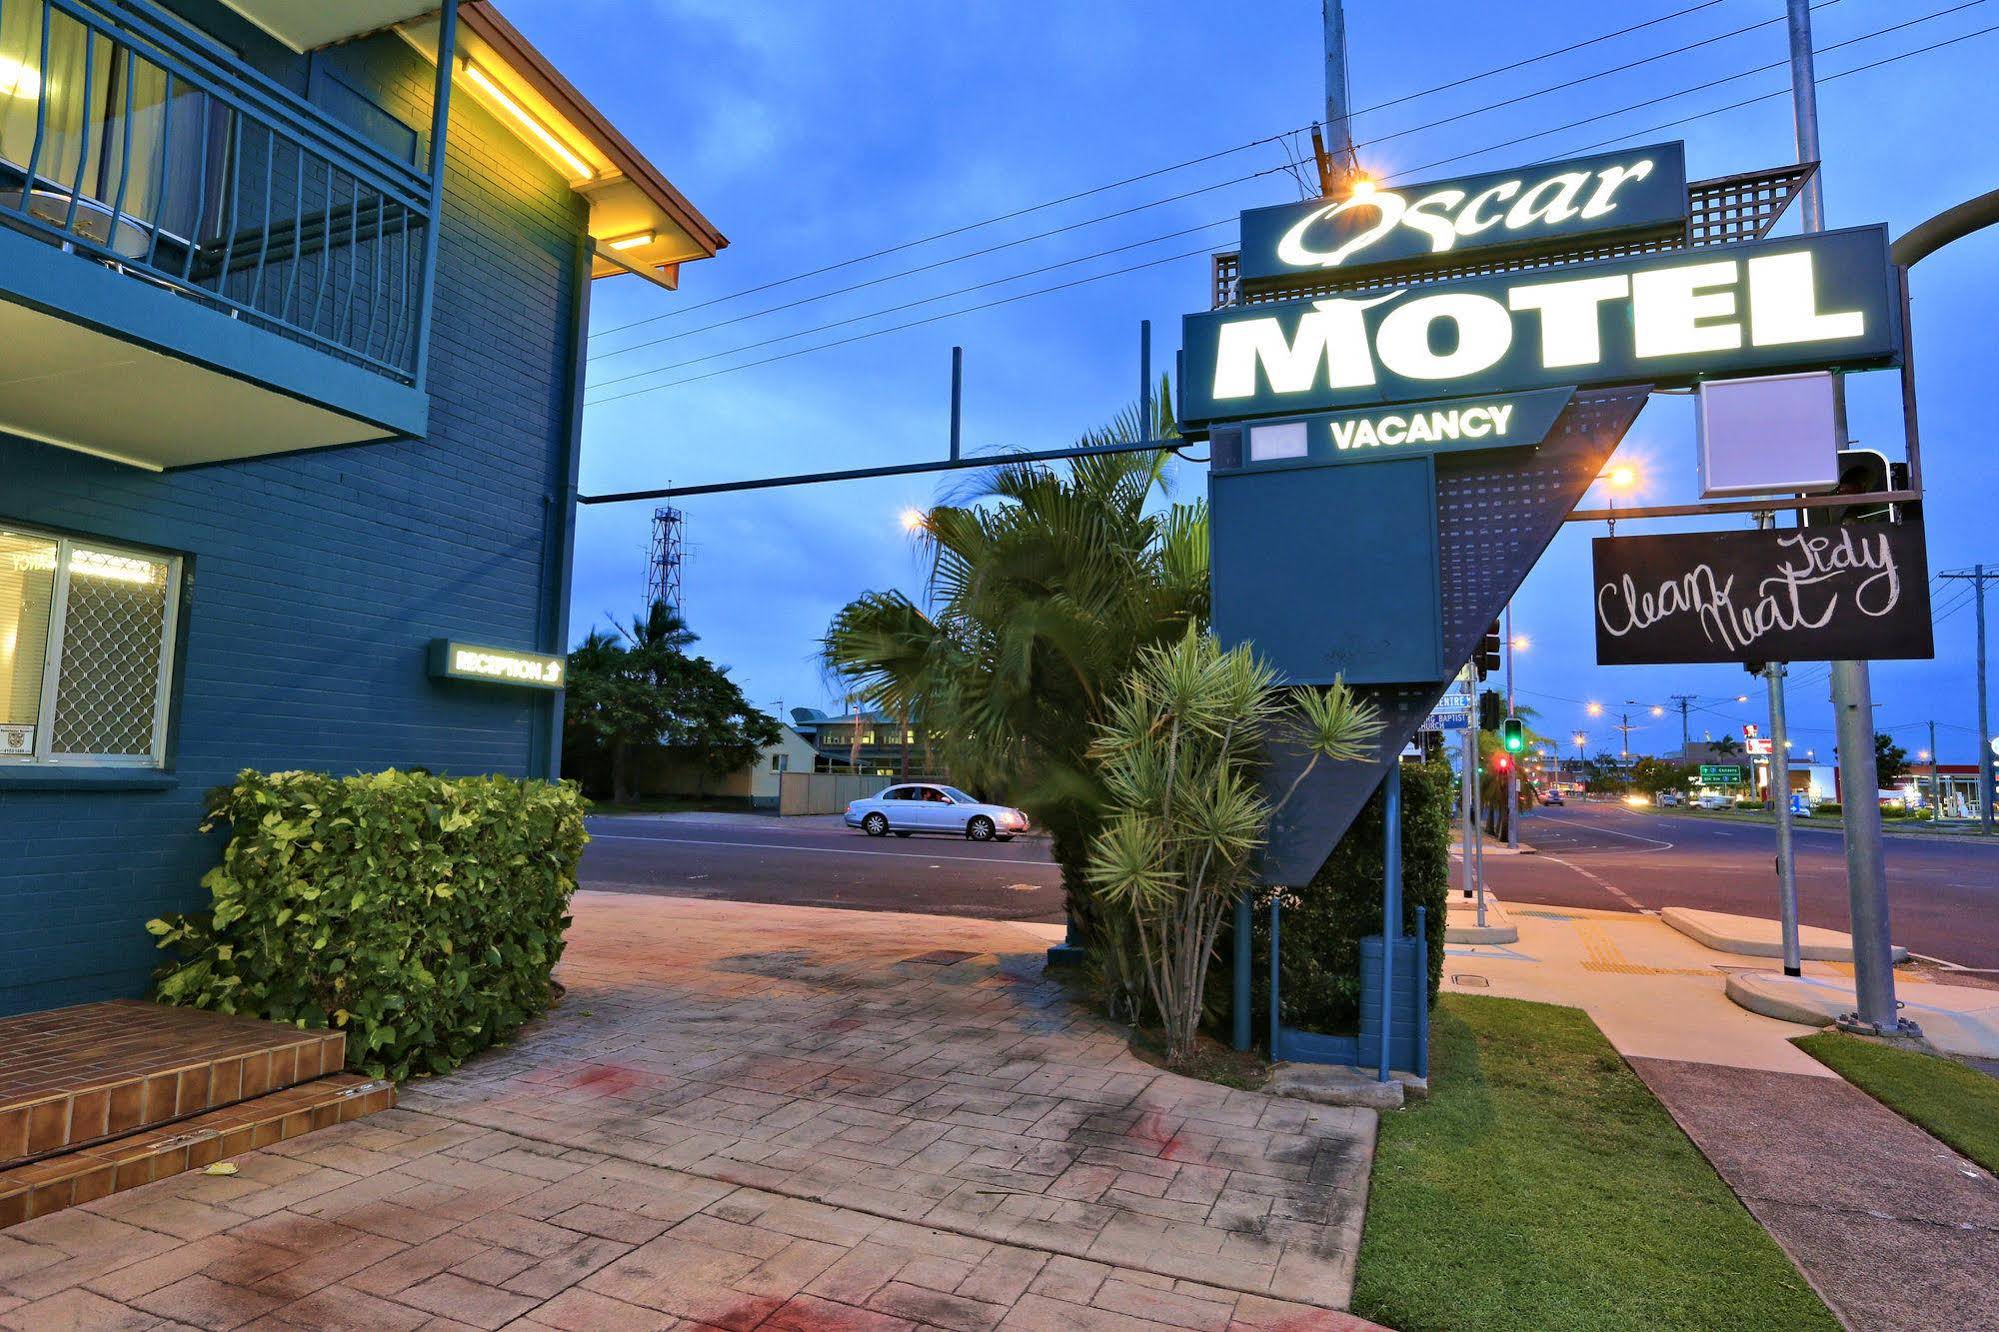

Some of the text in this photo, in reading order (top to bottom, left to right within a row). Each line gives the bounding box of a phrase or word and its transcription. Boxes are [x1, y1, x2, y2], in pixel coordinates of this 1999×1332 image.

[1278, 159, 1654, 267] Oscar
[1213, 250, 1865, 400] MOTEL
[1330, 404, 1513, 450] VACANCY
[1598, 563, 1734, 637] Clean
[1699, 560, 1846, 652] Neat
[1776, 527, 1900, 617] Tidy
[456, 650, 542, 681] RECEPTION
[1438, 696, 1464, 706] ENTRE
[1421, 721, 1444, 729] HURCH
